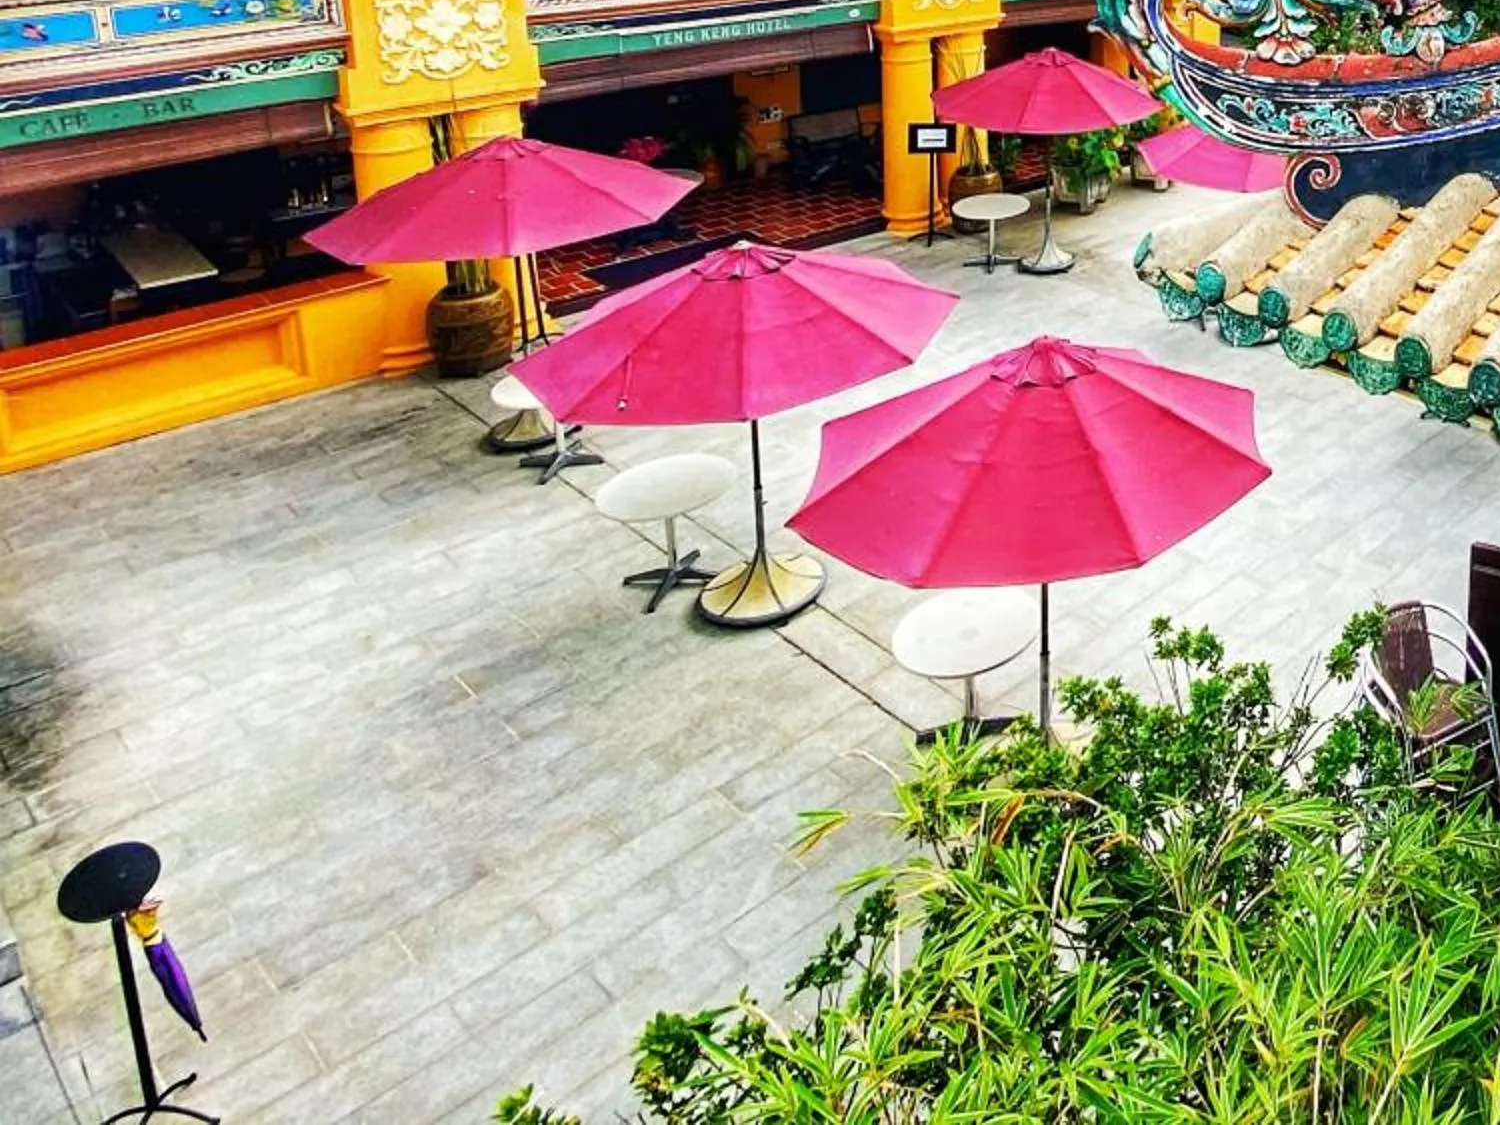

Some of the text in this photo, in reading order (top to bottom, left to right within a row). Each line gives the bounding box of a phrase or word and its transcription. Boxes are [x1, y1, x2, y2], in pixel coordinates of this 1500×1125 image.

[653, 17, 792, 47] YENG KENG HOTEL
[143, 96, 197, 119] BAR
